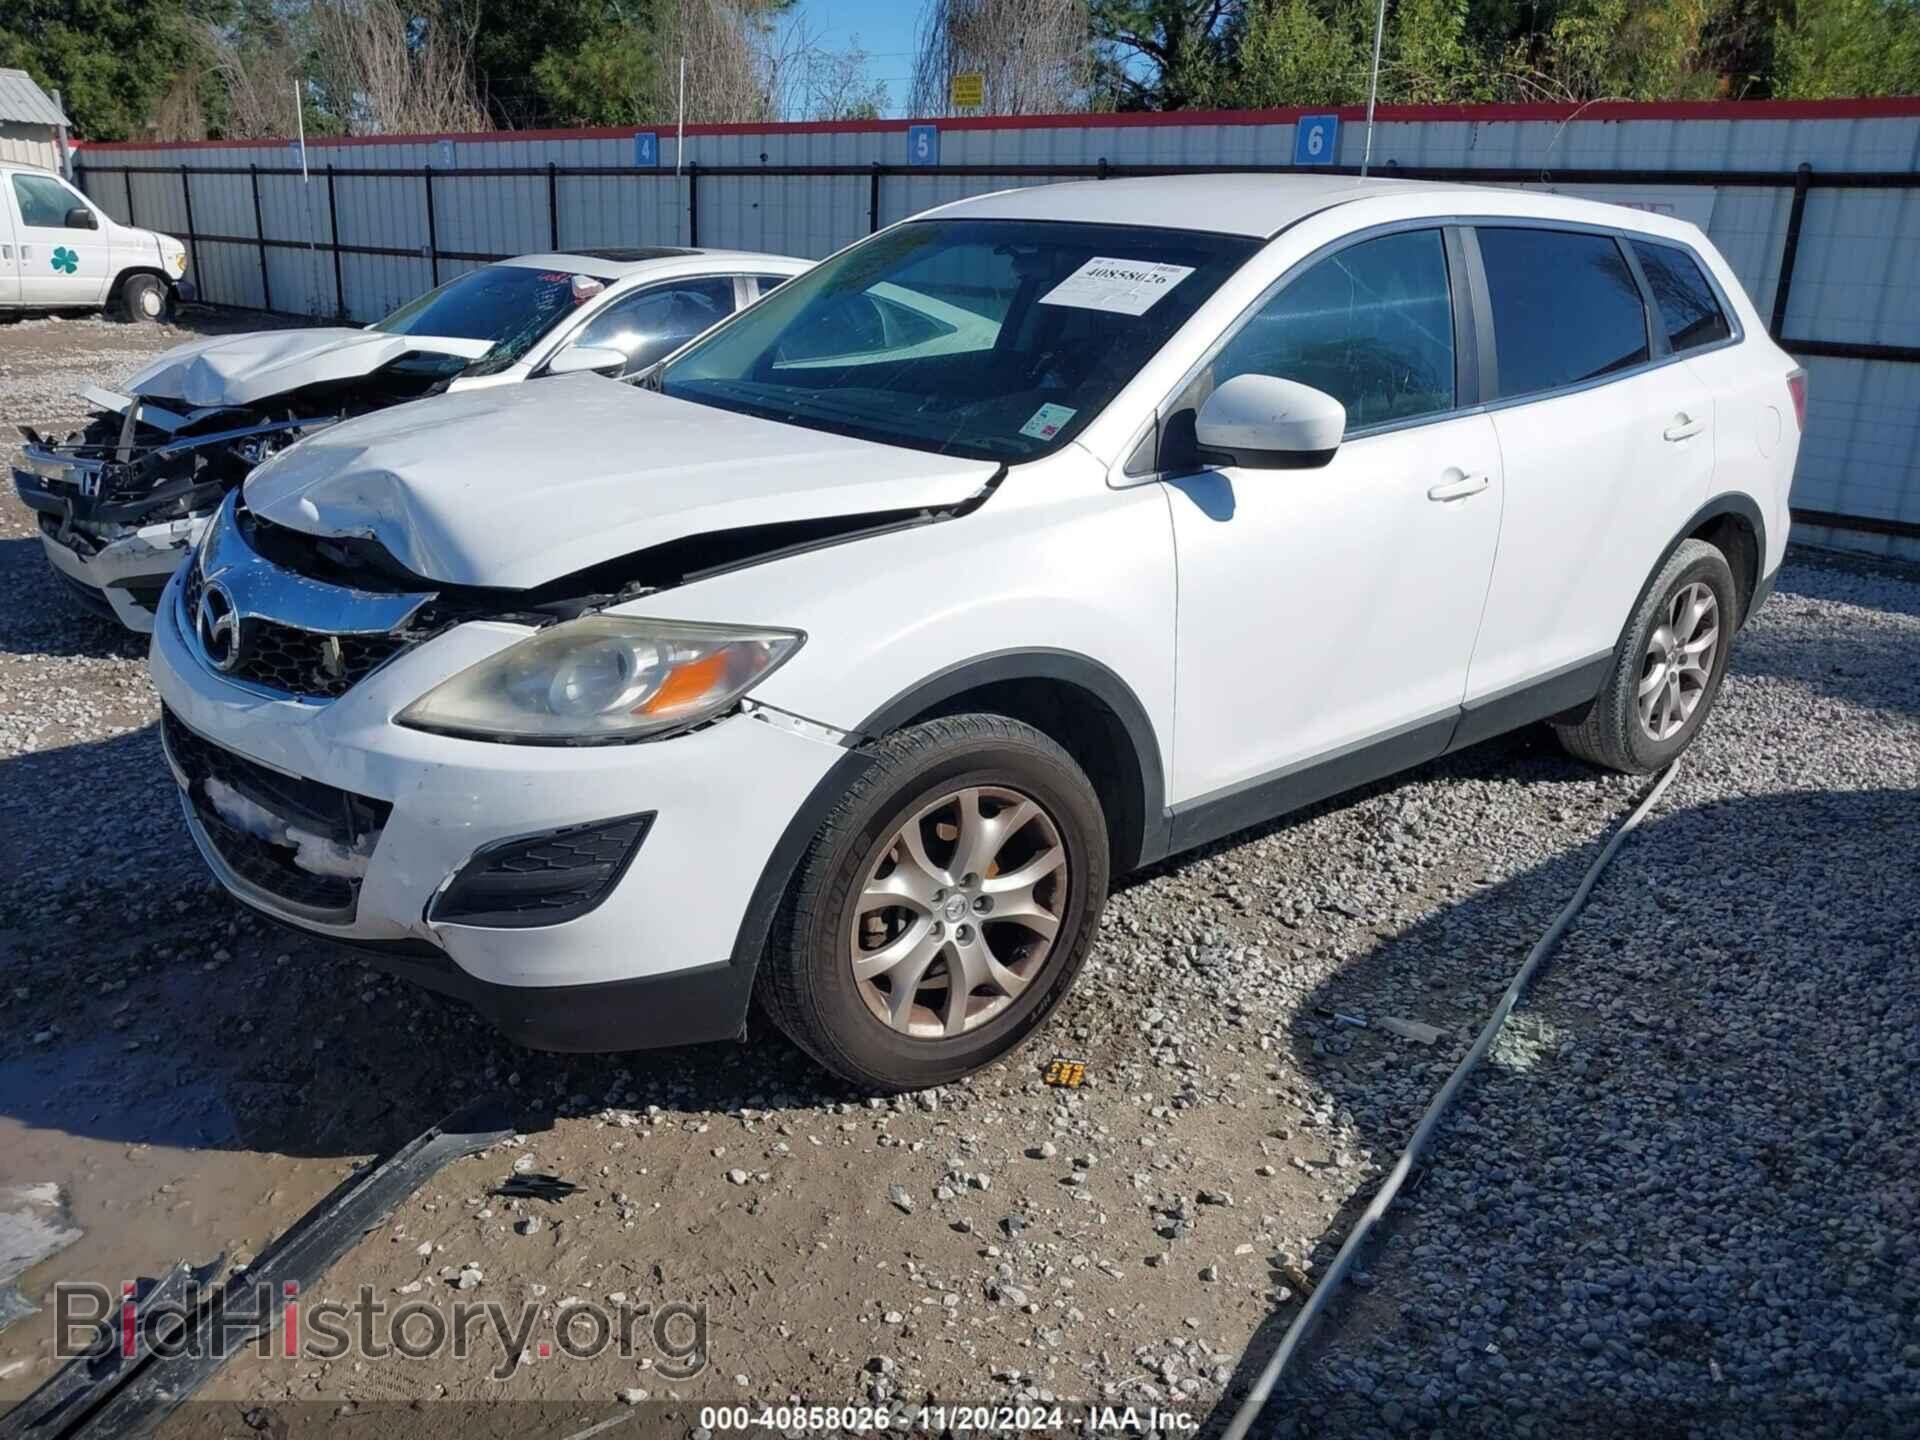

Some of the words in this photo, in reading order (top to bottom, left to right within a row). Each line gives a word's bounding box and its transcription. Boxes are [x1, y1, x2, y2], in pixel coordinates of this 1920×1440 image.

[641, 139, 650, 160] 4
[917, 132, 929, 158] 5
[1307, 125, 1324, 156] 6
[1085, 267, 1168, 285] 40858026
